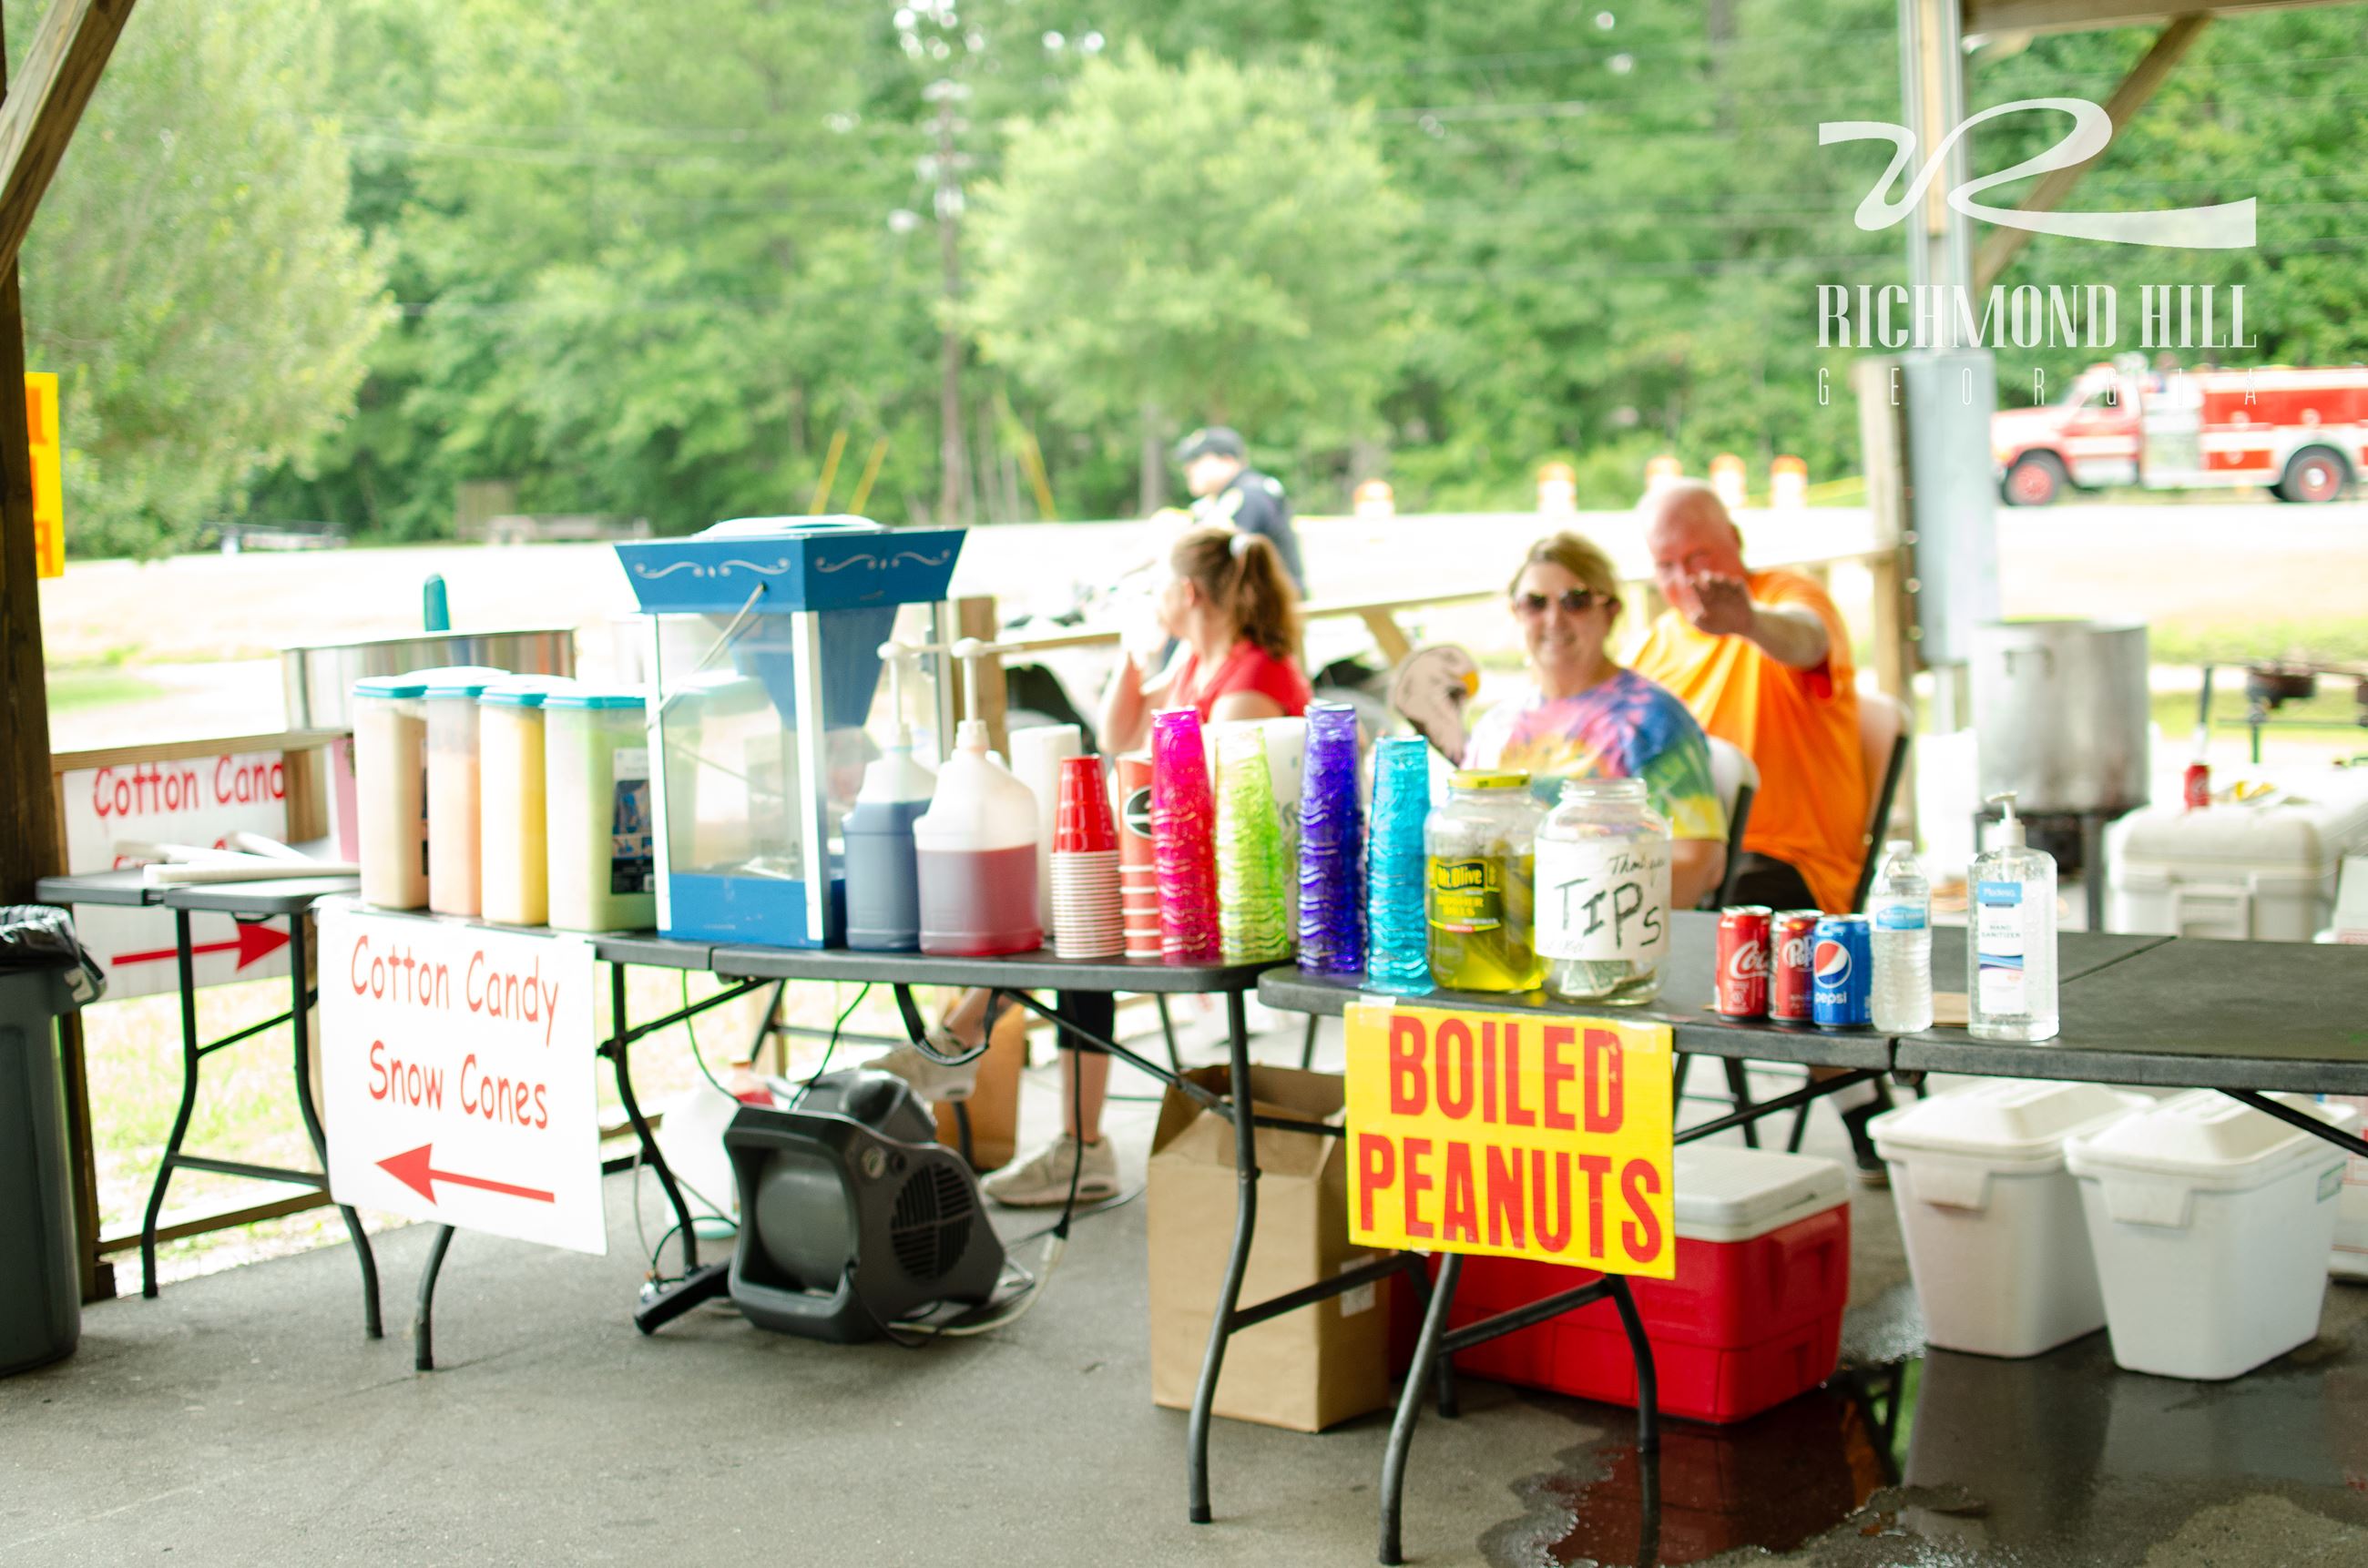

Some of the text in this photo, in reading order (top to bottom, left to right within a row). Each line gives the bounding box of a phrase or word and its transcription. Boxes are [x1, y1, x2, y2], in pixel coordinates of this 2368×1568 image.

[93, 761, 199, 818] Cotton
[352, 934, 558, 1047] Cotton Candy
[1814, 992, 1847, 1005] pepsi
[369, 1040, 547, 1129] Snow Cones
[1389, 1015, 1624, 1134] BOILED
[1358, 1133, 1662, 1263] PEANUTS
